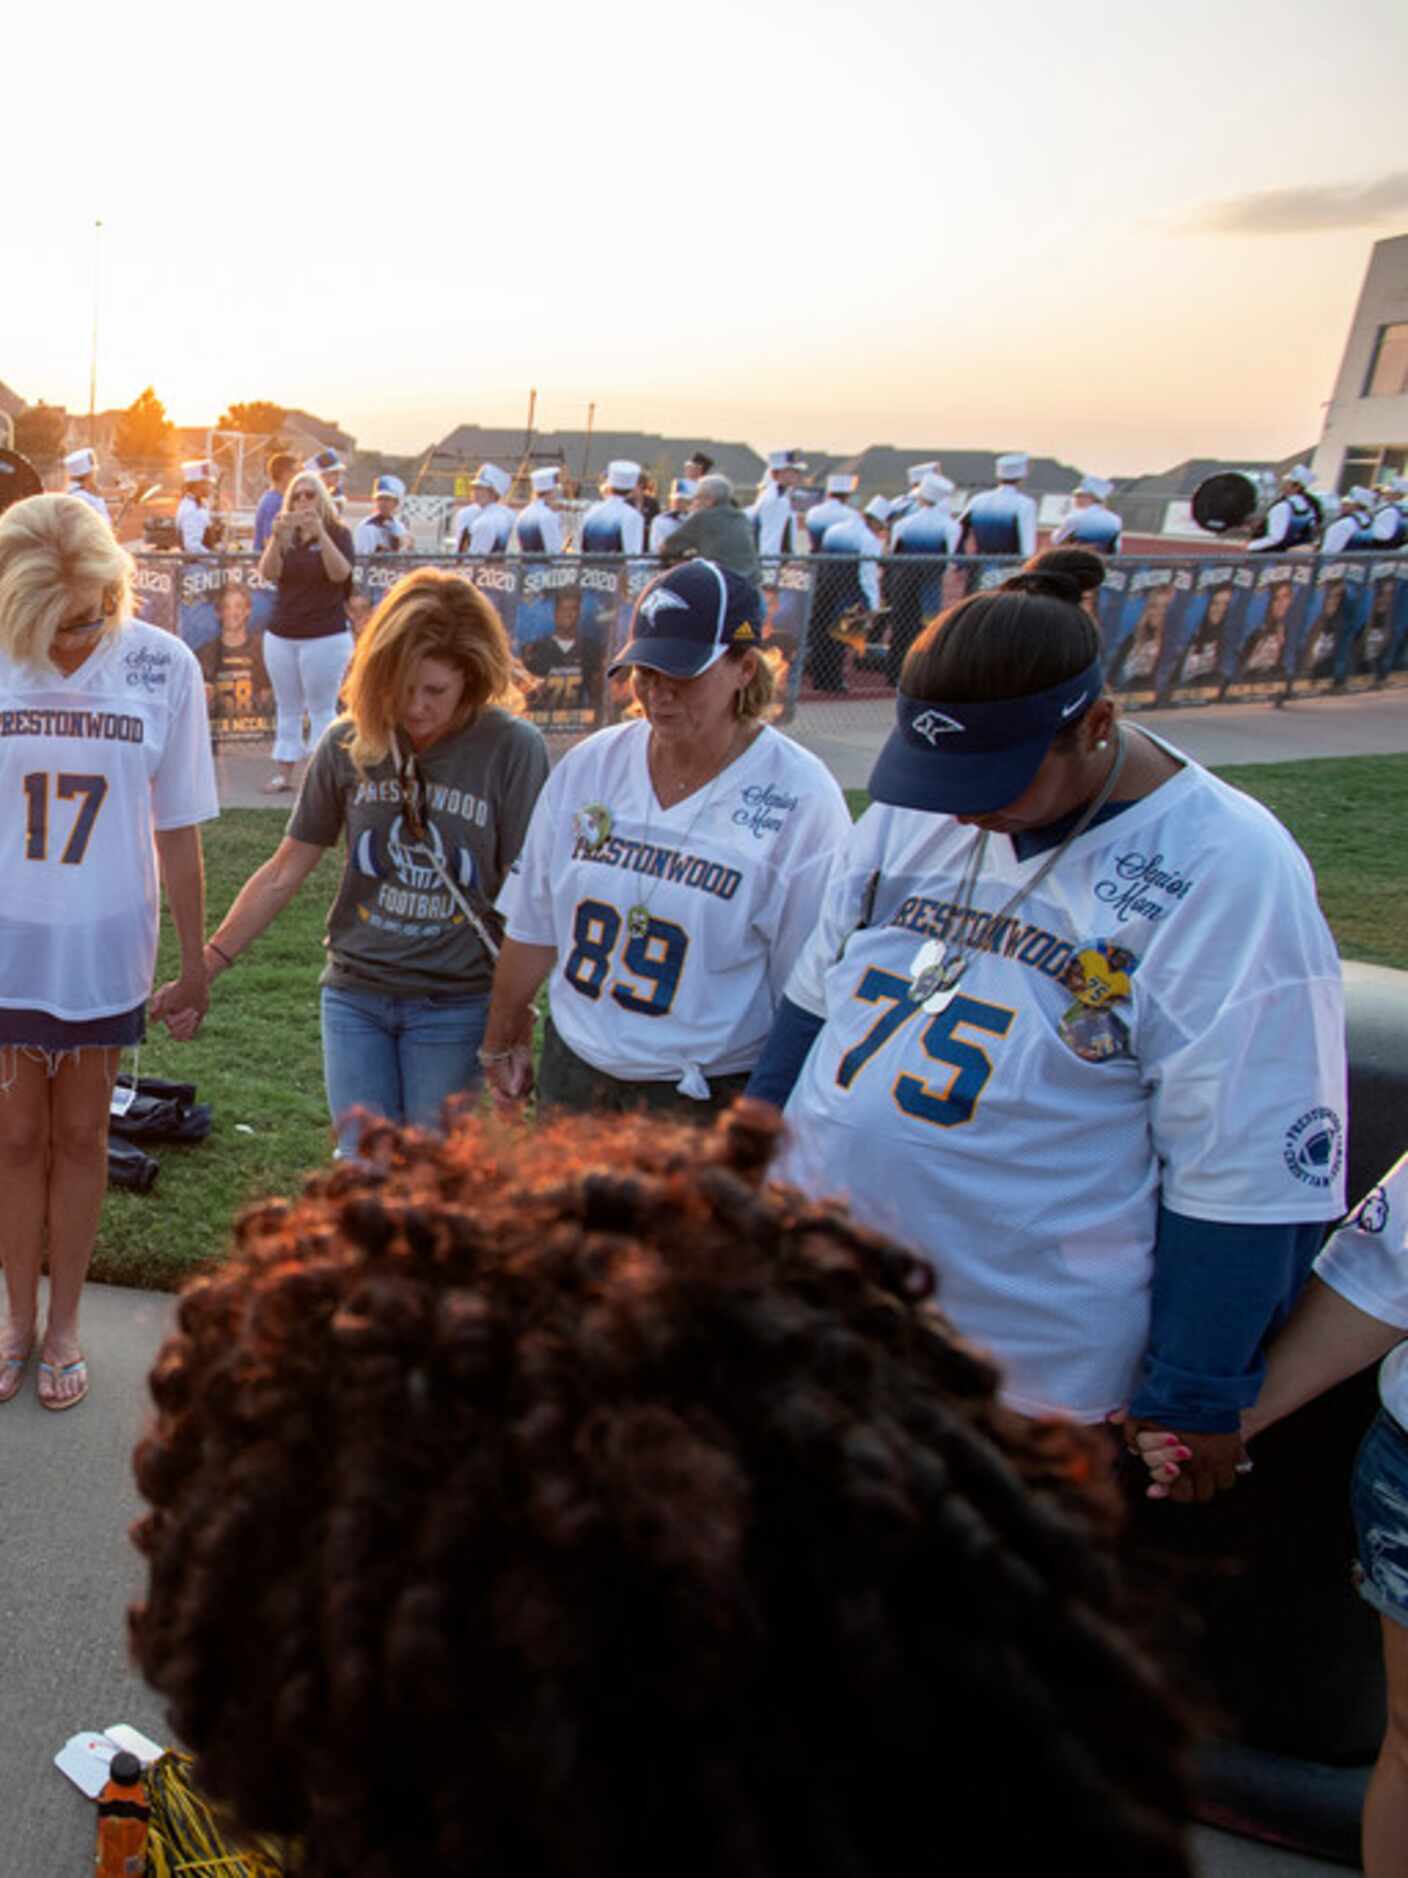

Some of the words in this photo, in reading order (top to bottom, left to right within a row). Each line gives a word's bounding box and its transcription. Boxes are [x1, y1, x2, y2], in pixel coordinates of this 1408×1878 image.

[182, 567, 243, 593] SENIOR
[476, 567, 516, 593] 2020
[523, 568, 578, 593] SENIOR
[580, 567, 618, 593] 2020
[22, 771, 109, 865] 17
[1114, 852, 1194, 900] Senior
[1093, 880, 1172, 922] Mom
[565, 897, 689, 1017] 89
[835, 964, 1017, 1130] 75
